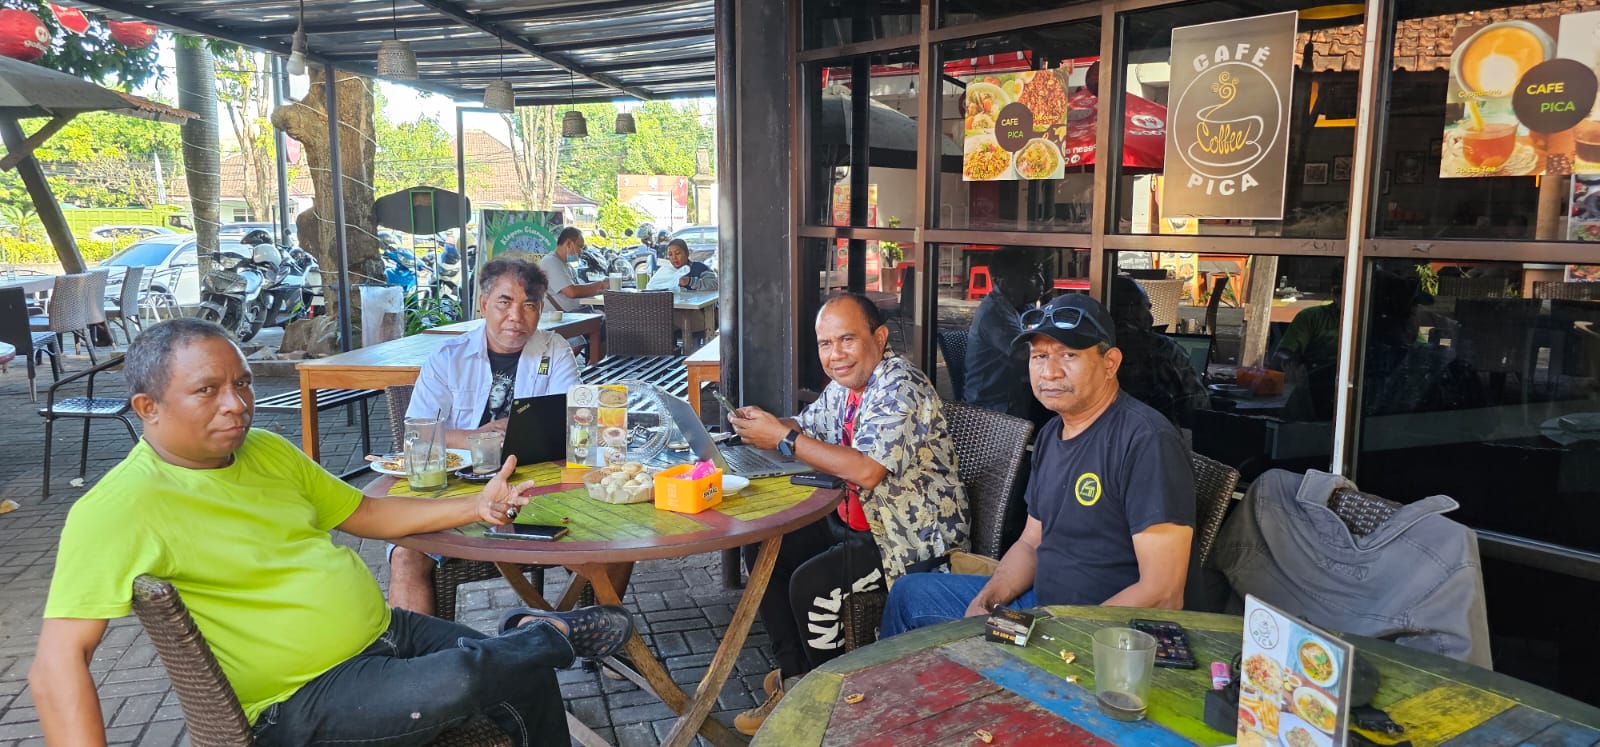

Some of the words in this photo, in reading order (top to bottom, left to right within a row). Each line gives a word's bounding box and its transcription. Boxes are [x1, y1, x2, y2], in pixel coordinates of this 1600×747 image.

[1193, 43, 1270, 73] CAFÉ
[1526, 82, 1565, 95] CAFE
[1540, 101, 1576, 113] PICA
[1001, 118, 1019, 126] CAFE
[1007, 131, 1024, 139] PICA
[1196, 121, 1252, 155] Coffee
[1187, 172, 1259, 196] PICA
